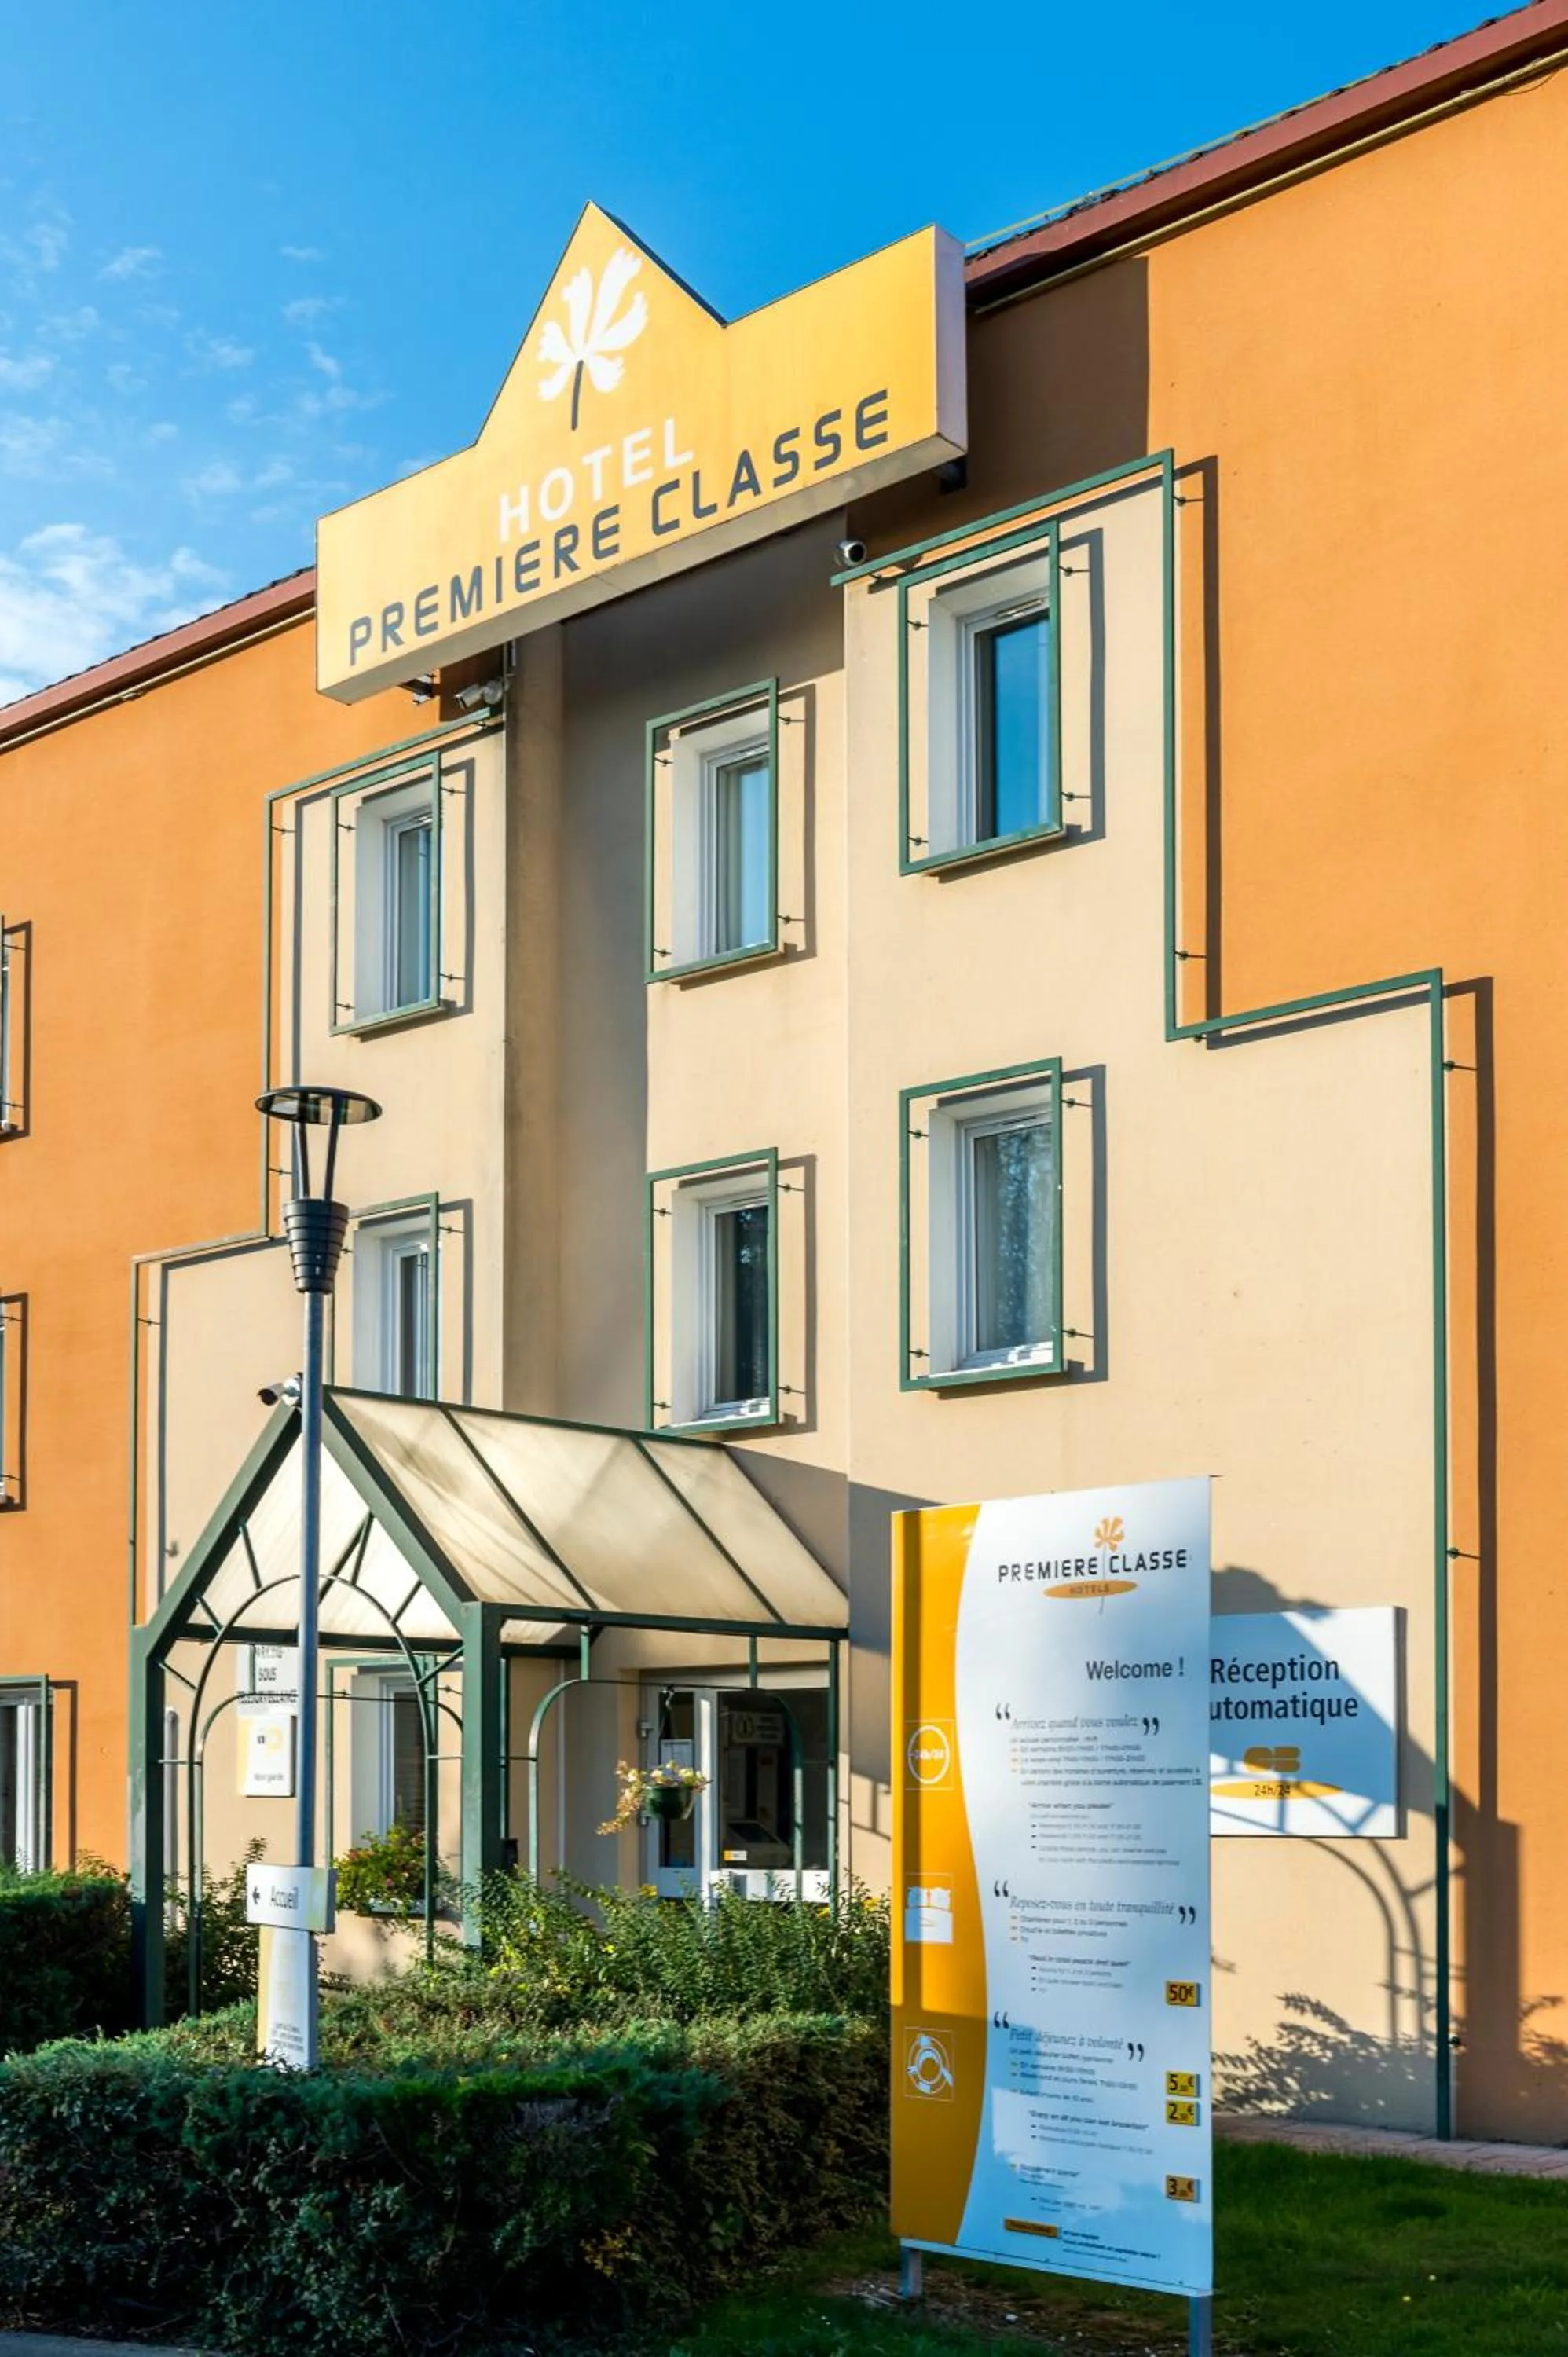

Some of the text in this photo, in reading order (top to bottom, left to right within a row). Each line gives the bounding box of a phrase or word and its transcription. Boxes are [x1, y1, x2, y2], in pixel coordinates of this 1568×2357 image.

[500, 418, 694, 543] HOTEL
[348, 388, 889, 667] PREMIERE CLASSE
[998, 1549, 1188, 1583] PREMIERE CLASSE
[1086, 1656, 1185, 1681] Welcome !
[1210, 1653, 1340, 1690] Réception
[1210, 1691, 1359, 1726] utomatique
[1254, 1783, 1291, 1797] 24h/24
[269, 1885, 299, 1910] Accueil
[1168, 1984, 1195, 2003] 50€
